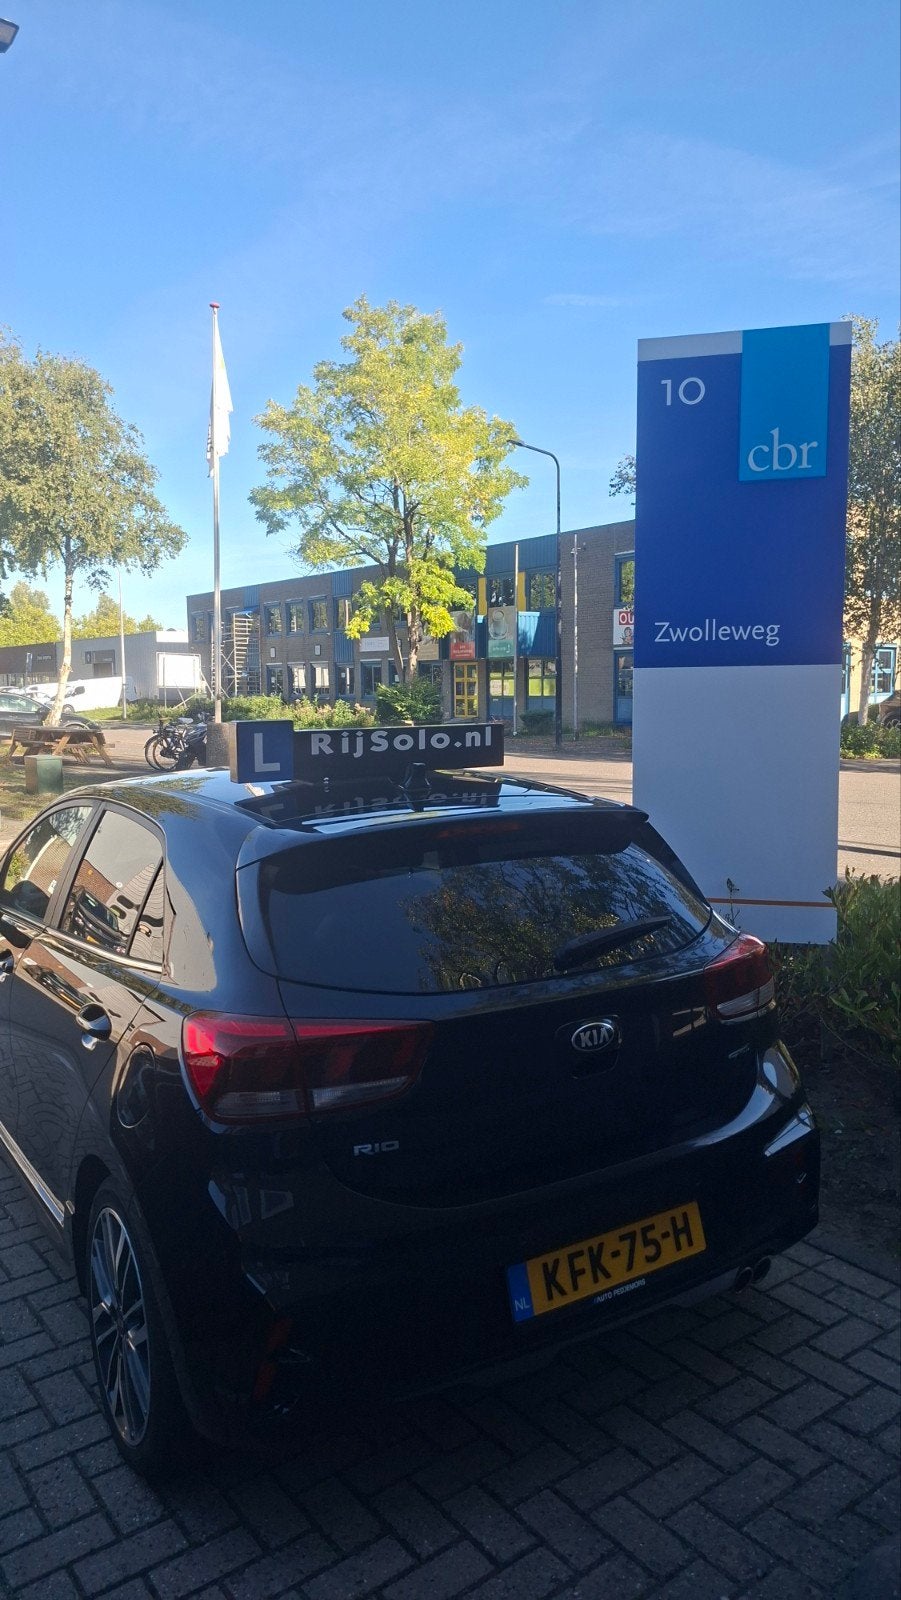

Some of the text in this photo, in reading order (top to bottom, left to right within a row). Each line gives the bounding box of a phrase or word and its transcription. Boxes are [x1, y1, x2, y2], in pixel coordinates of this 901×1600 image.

[661, 377, 706, 406] 10
[747, 427, 819, 472] cbr
[654, 619, 781, 647] Zwolleweg
[253, 732, 281, 773] L
[310, 726, 492, 758] RijSolo.nl
[579, 1027, 609, 1048] KIA
[353, 1140, 400, 1157] RIO
[541, 1211, 694, 1301] KFK-75-H
[514, 1297, 531, 1312] NL
[596, 1290, 613, 1303] AUTO
